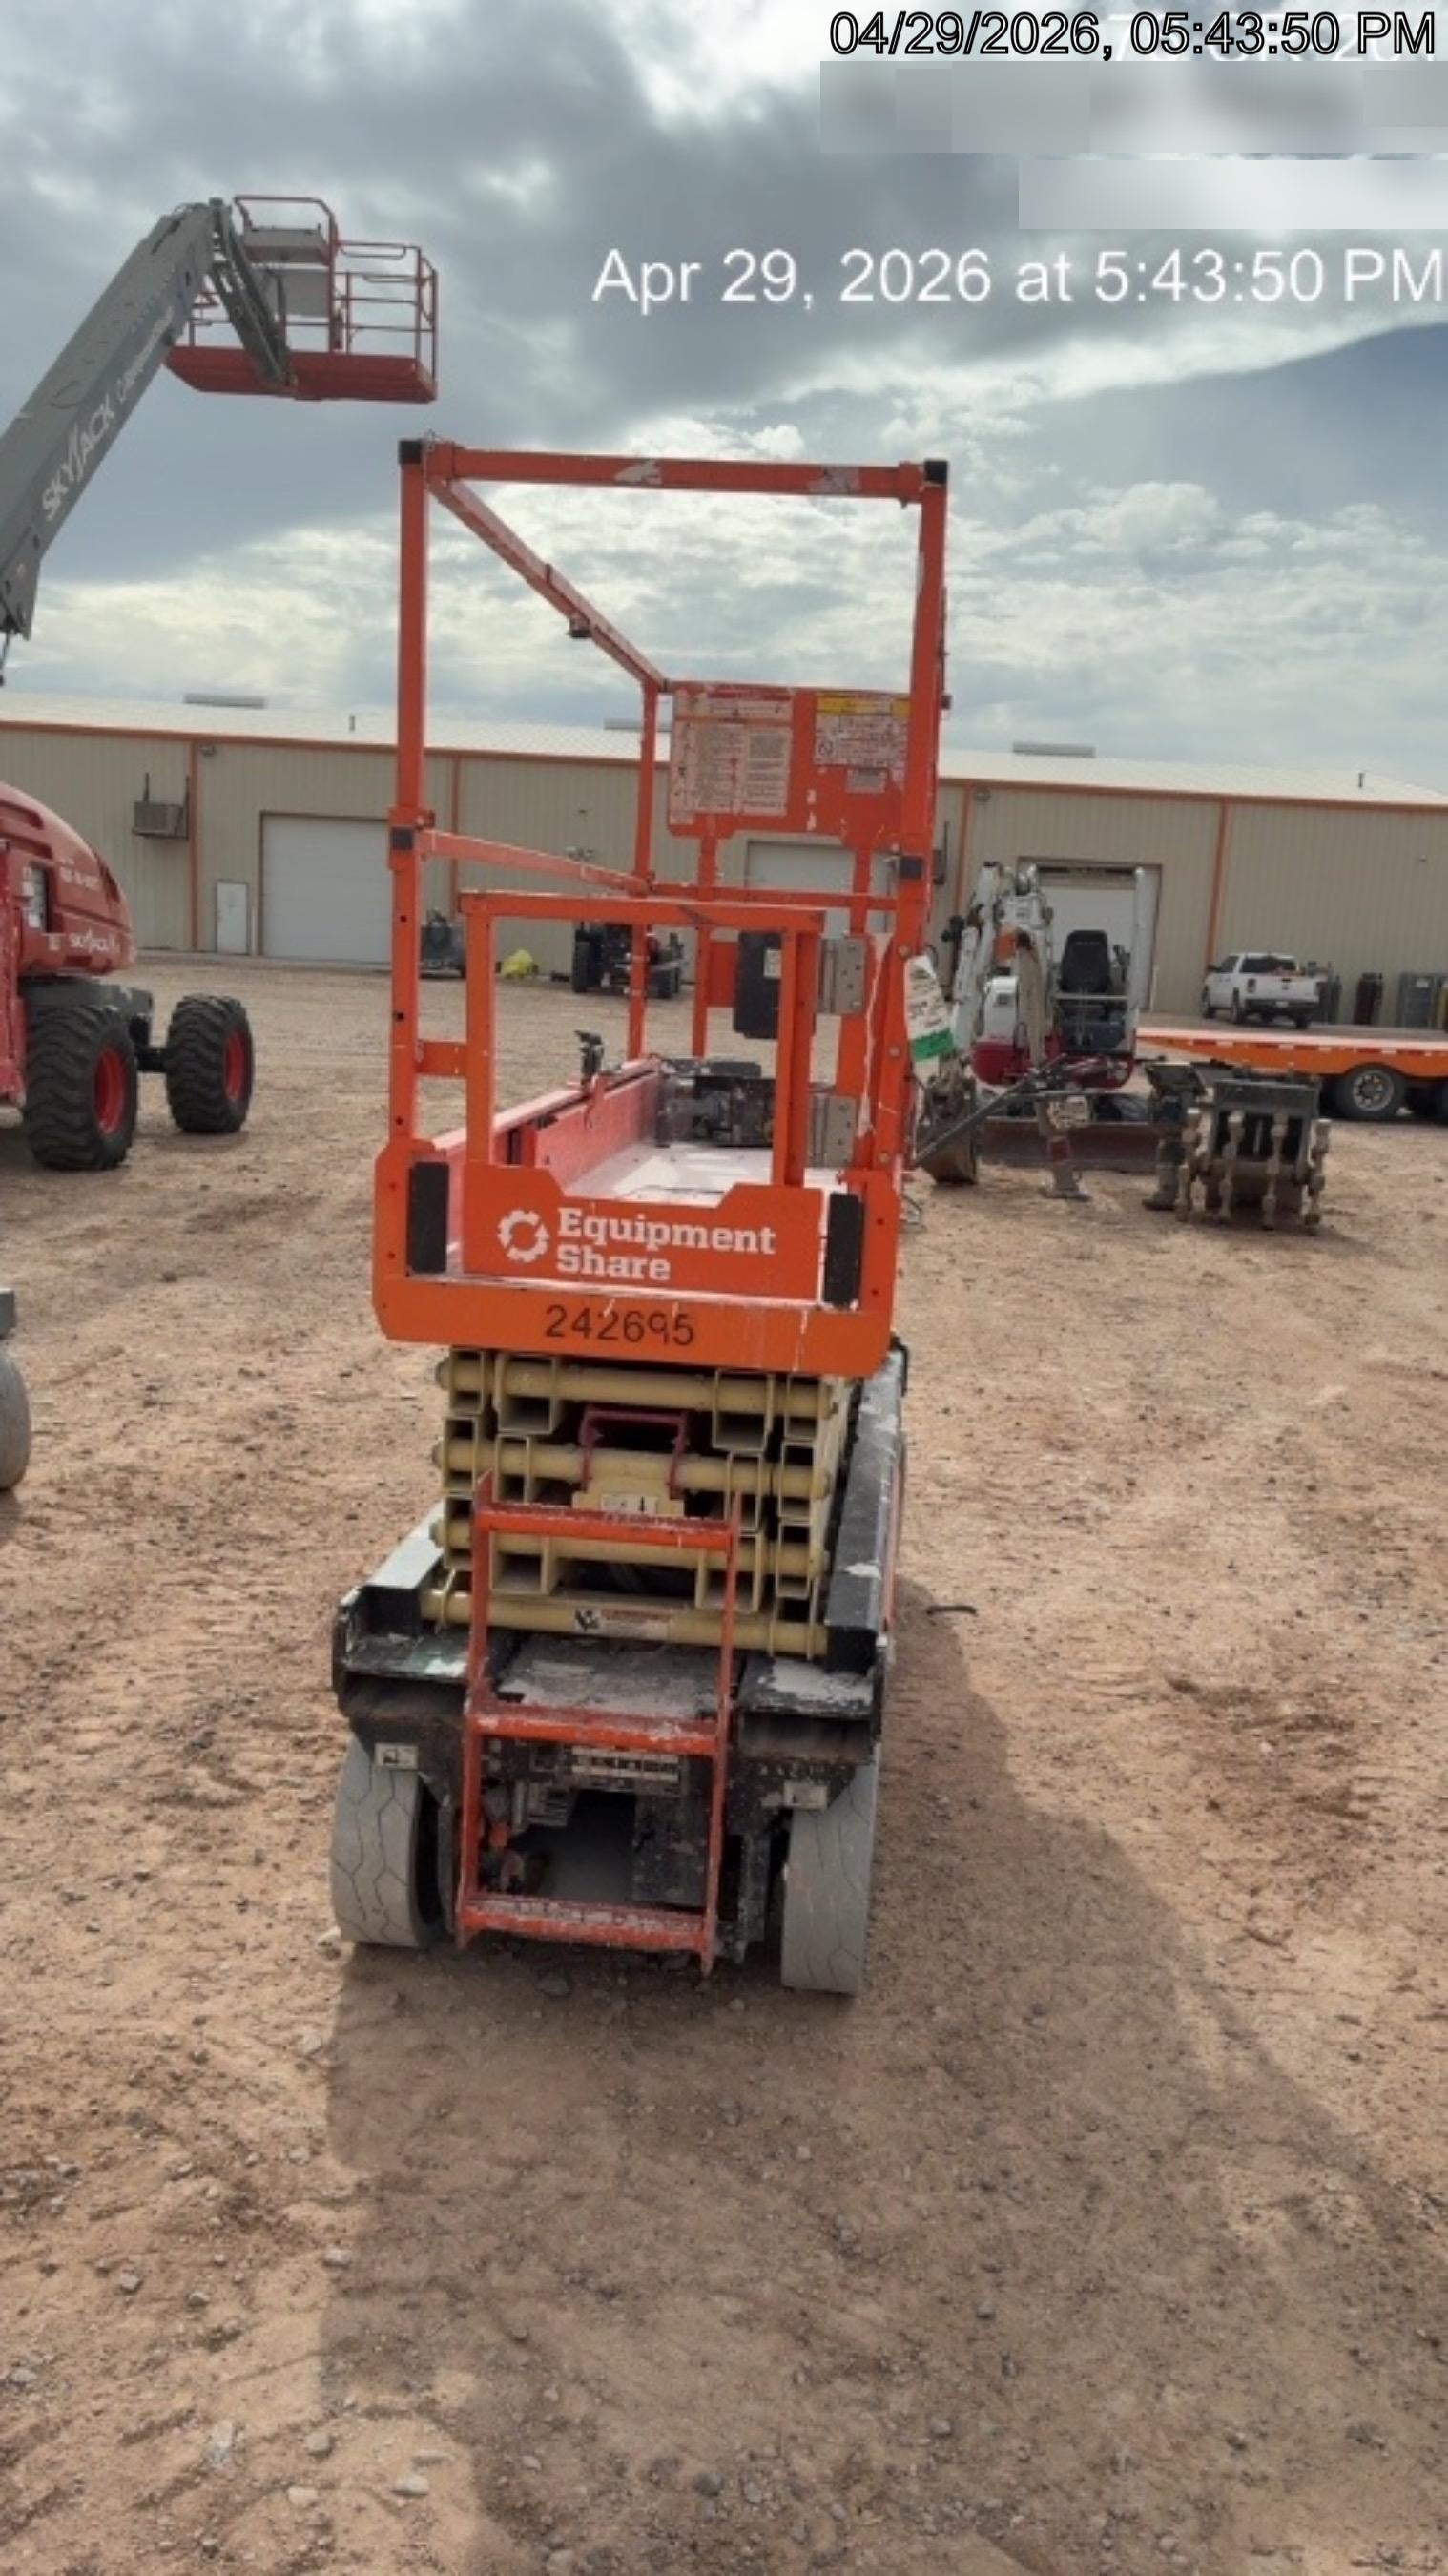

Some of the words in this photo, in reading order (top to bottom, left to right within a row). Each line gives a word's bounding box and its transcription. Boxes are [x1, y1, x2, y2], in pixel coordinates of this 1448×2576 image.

[42, 391, 115, 522] SKYJACK
[557, 1206, 776, 1255] Equipment
[555, 1243, 671, 1280] Share
[545, 1303, 695, 1347] 242695
